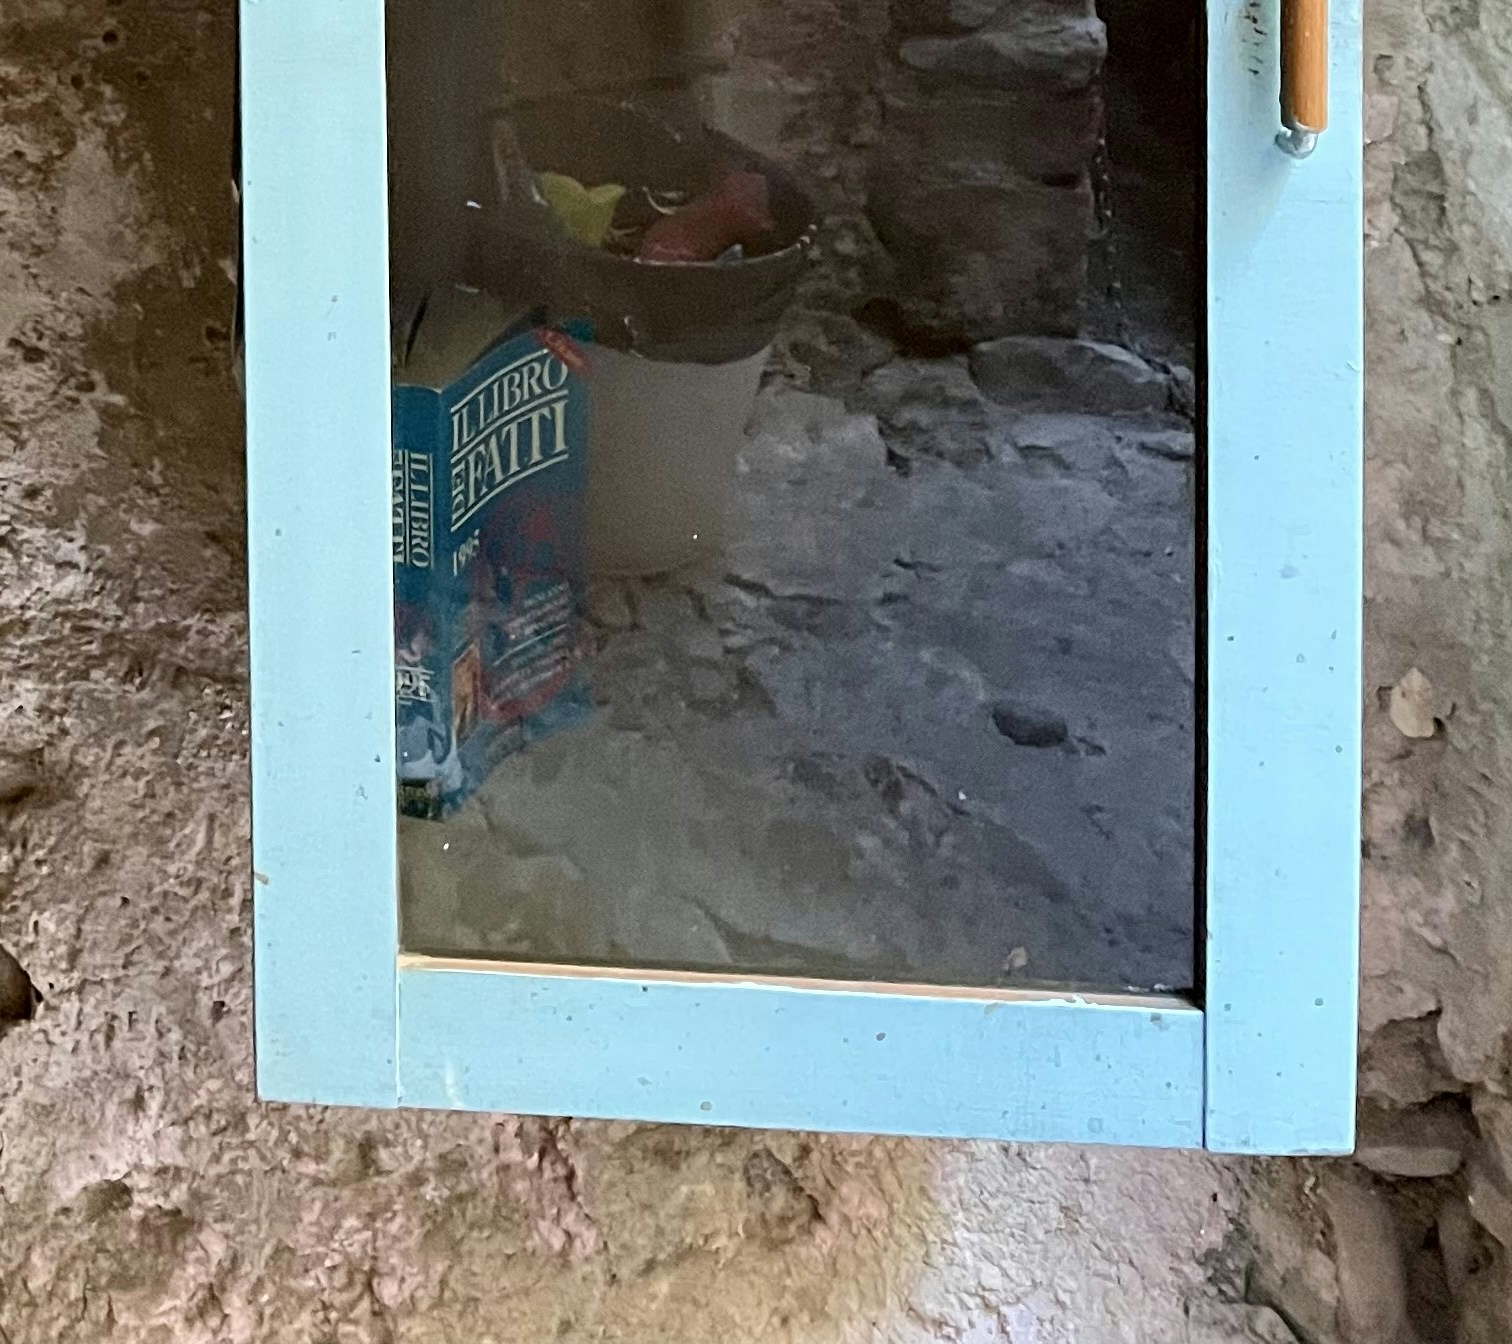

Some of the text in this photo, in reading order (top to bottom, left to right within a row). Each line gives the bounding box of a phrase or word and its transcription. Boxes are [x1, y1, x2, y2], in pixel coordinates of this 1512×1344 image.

[451, 354, 569, 453] IL LIBRO
[465, 398, 569, 511] FATTI
[410, 451, 430, 568] IL LIBRO
